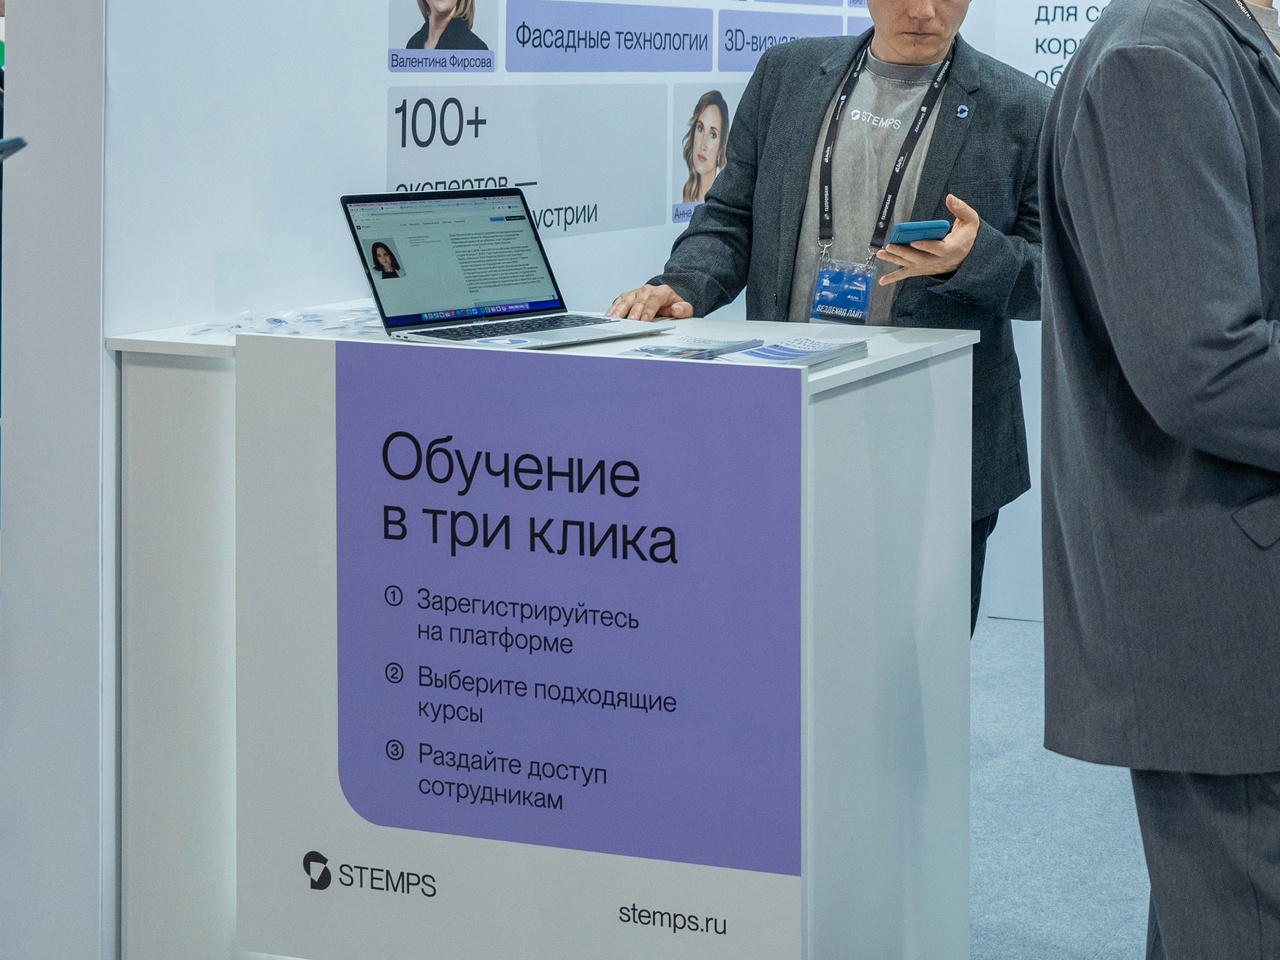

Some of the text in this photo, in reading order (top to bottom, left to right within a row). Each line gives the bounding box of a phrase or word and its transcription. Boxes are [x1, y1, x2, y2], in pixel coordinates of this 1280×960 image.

[1034, 6, 1077, 25] для
[516, 21, 709, 53] Фасадные технологии
[724, 28, 800, 52] 3D-виз
[1035, 38, 1082, 59] кор
[391, 53, 492, 71] Валентина Фирсова
[394, 97, 487, 148] 100+
[861, 111, 902, 130] STEMPS
[382, 431, 640, 498] Обучение
[383, 505, 678, 564] в три клика
[417, 588, 639, 629] Зарегистрируйтесь
[418, 623, 574, 655] на платформе
[418, 665, 528, 696] Выберите
[534, 681, 677, 714] подходящие
[418, 702, 483, 724] курсы
[418, 743, 522, 775] Раздайте
[527, 759, 608, 785] доступ
[418, 777, 563, 811] сотрудникам
[338, 864, 437, 898] STEMPS
[618, 902, 727, 935] stemps.ru
